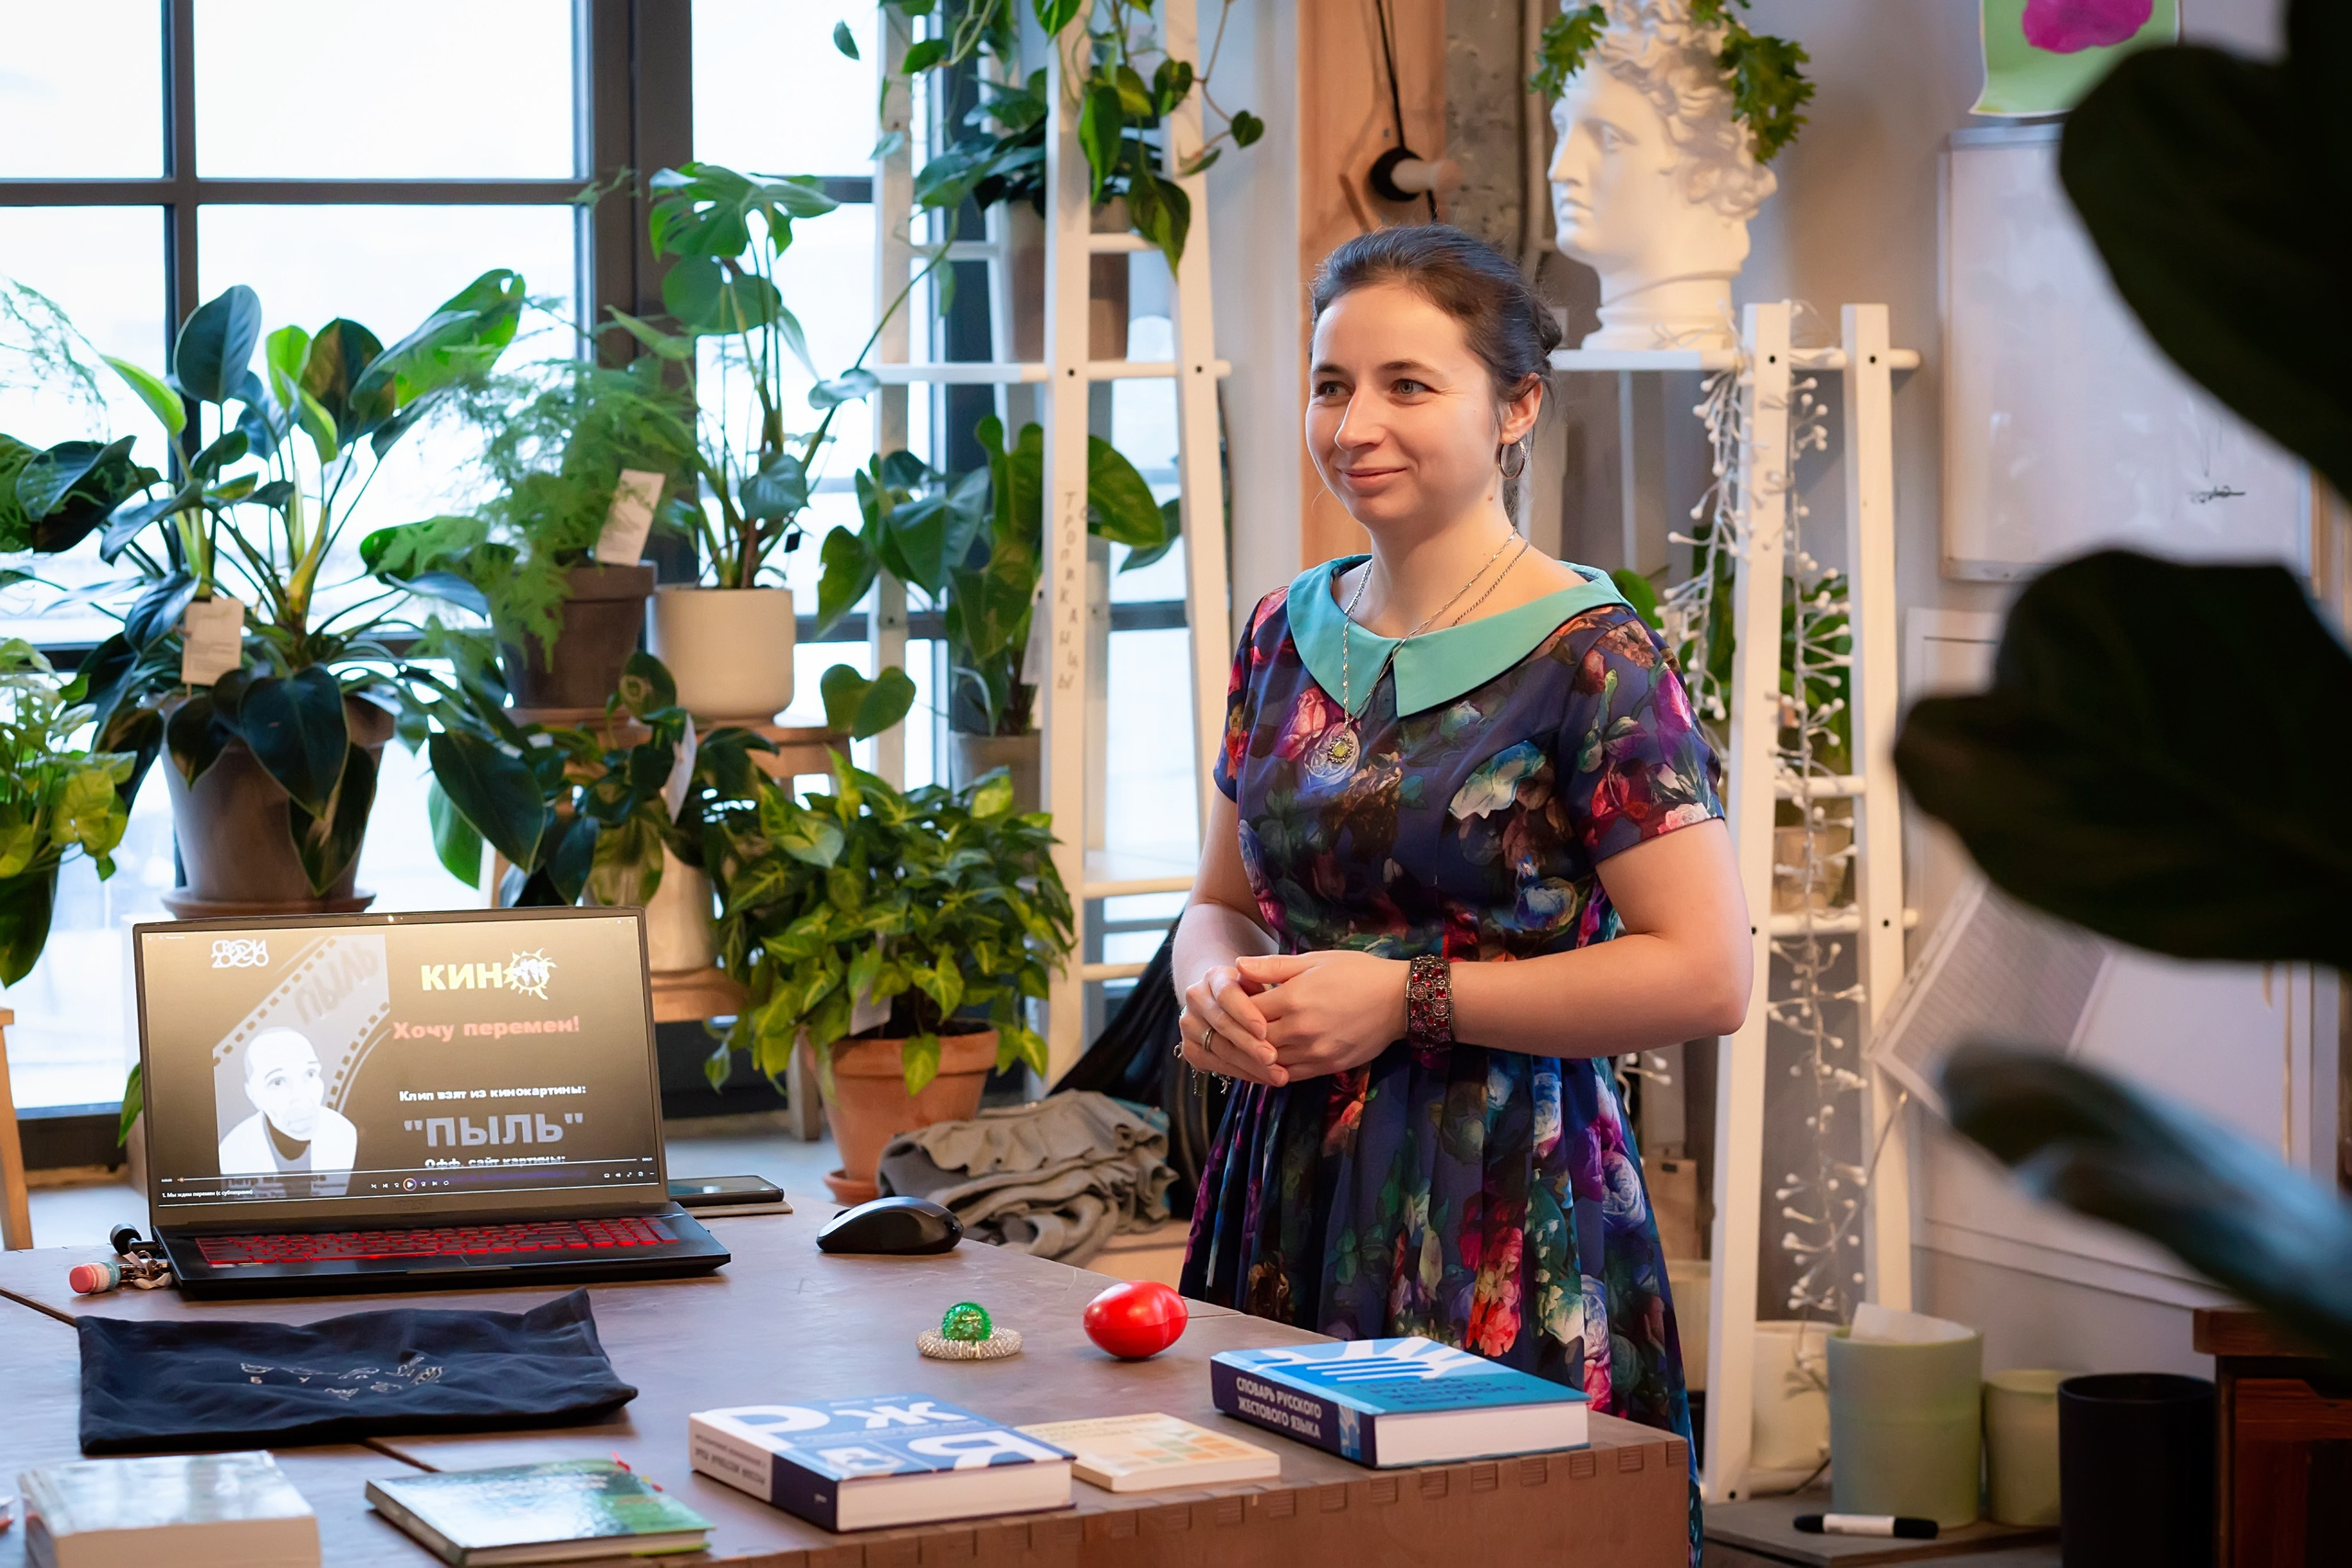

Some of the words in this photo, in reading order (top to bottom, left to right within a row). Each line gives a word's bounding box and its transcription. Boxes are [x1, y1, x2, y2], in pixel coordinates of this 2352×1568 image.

[392, 1021, 455, 1043] Хочу
[463, 1015, 580, 1040] перемен!
[399, 1090, 435, 1101] Клип
[437, 1090, 467, 1100] взят
[470, 1089, 487, 1100] из
[490, 1086, 586, 1099] кинокартины:
[403, 1112, 583, 1147] "ПЫЛЬ"
[1236, 1377, 1275, 1403] СЛОВАРЬ
[1276, 1390, 1322, 1419] РУССКОГО
[1238, 1395, 1289, 1427] ЖЕСТОВОГО
[1290, 1413, 1321, 1438] ЯЗЫКА
